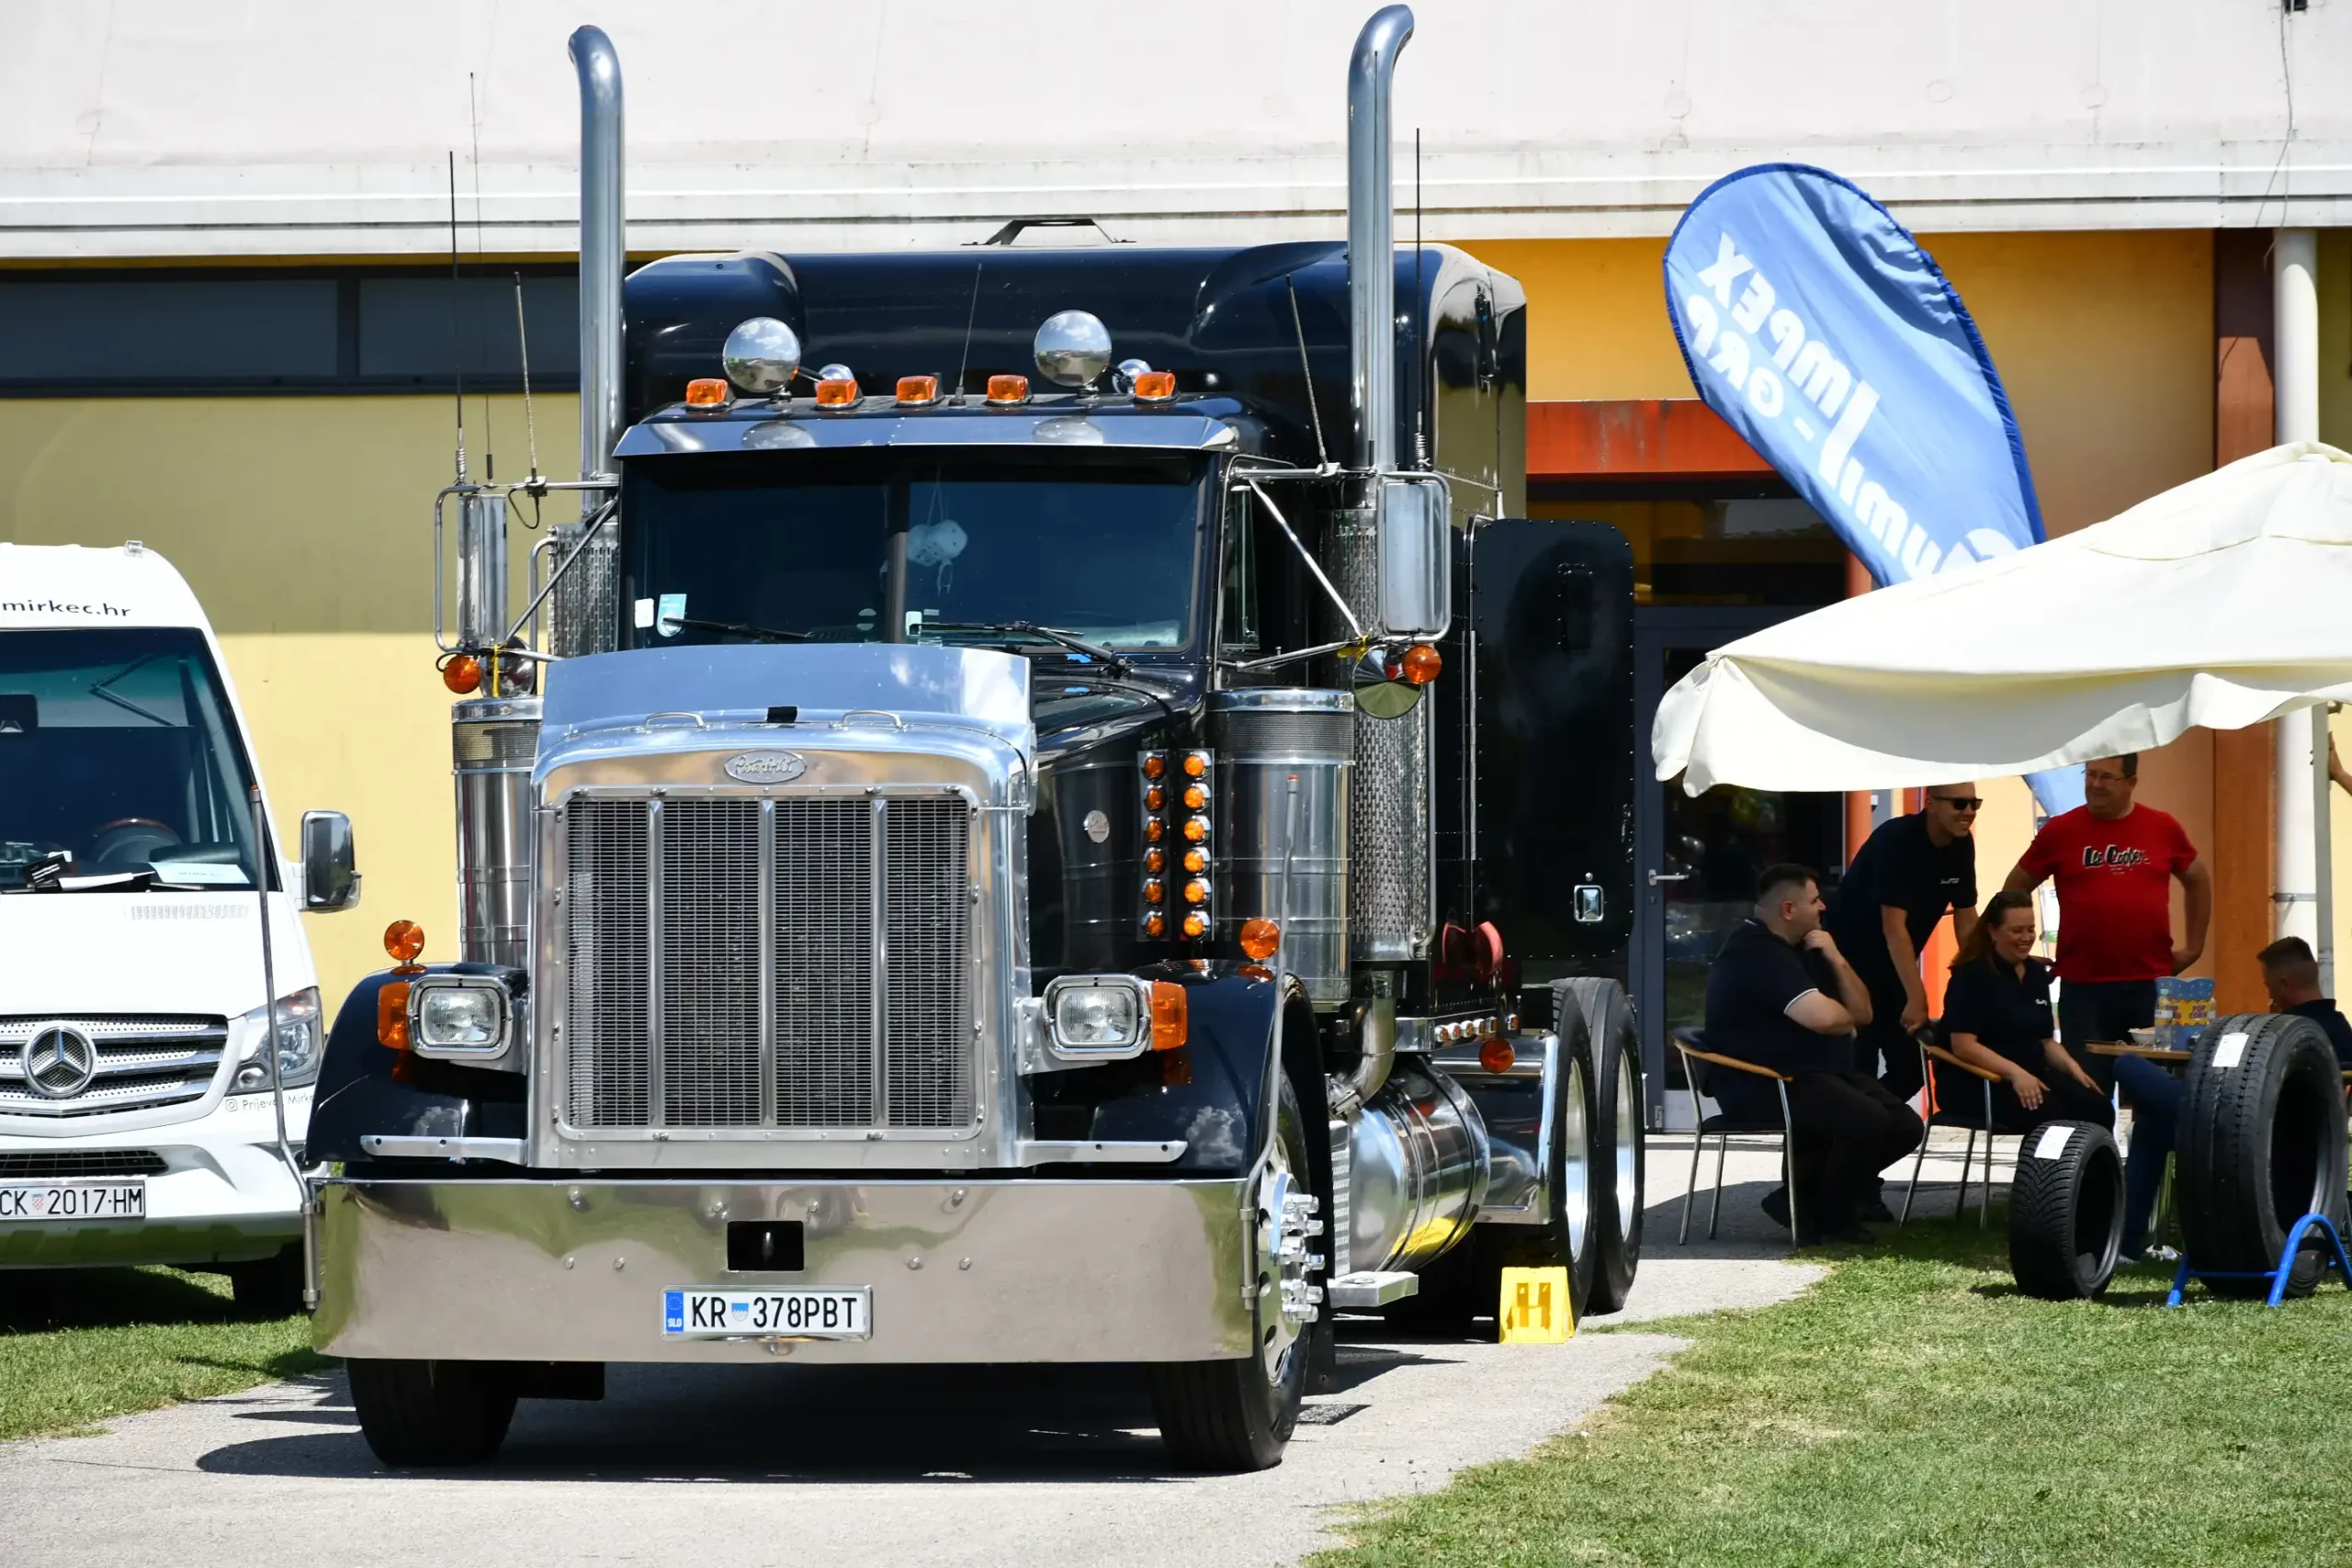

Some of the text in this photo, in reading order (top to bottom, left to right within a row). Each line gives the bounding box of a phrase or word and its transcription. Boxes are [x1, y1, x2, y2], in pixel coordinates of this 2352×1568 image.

[2, 599, 131, 617] mirkec.hr
[0, 1190, 28, 1216] CK
[667, 1317, 683, 1328] SLO
[692, 1296, 857, 1328] KR 378PBT
